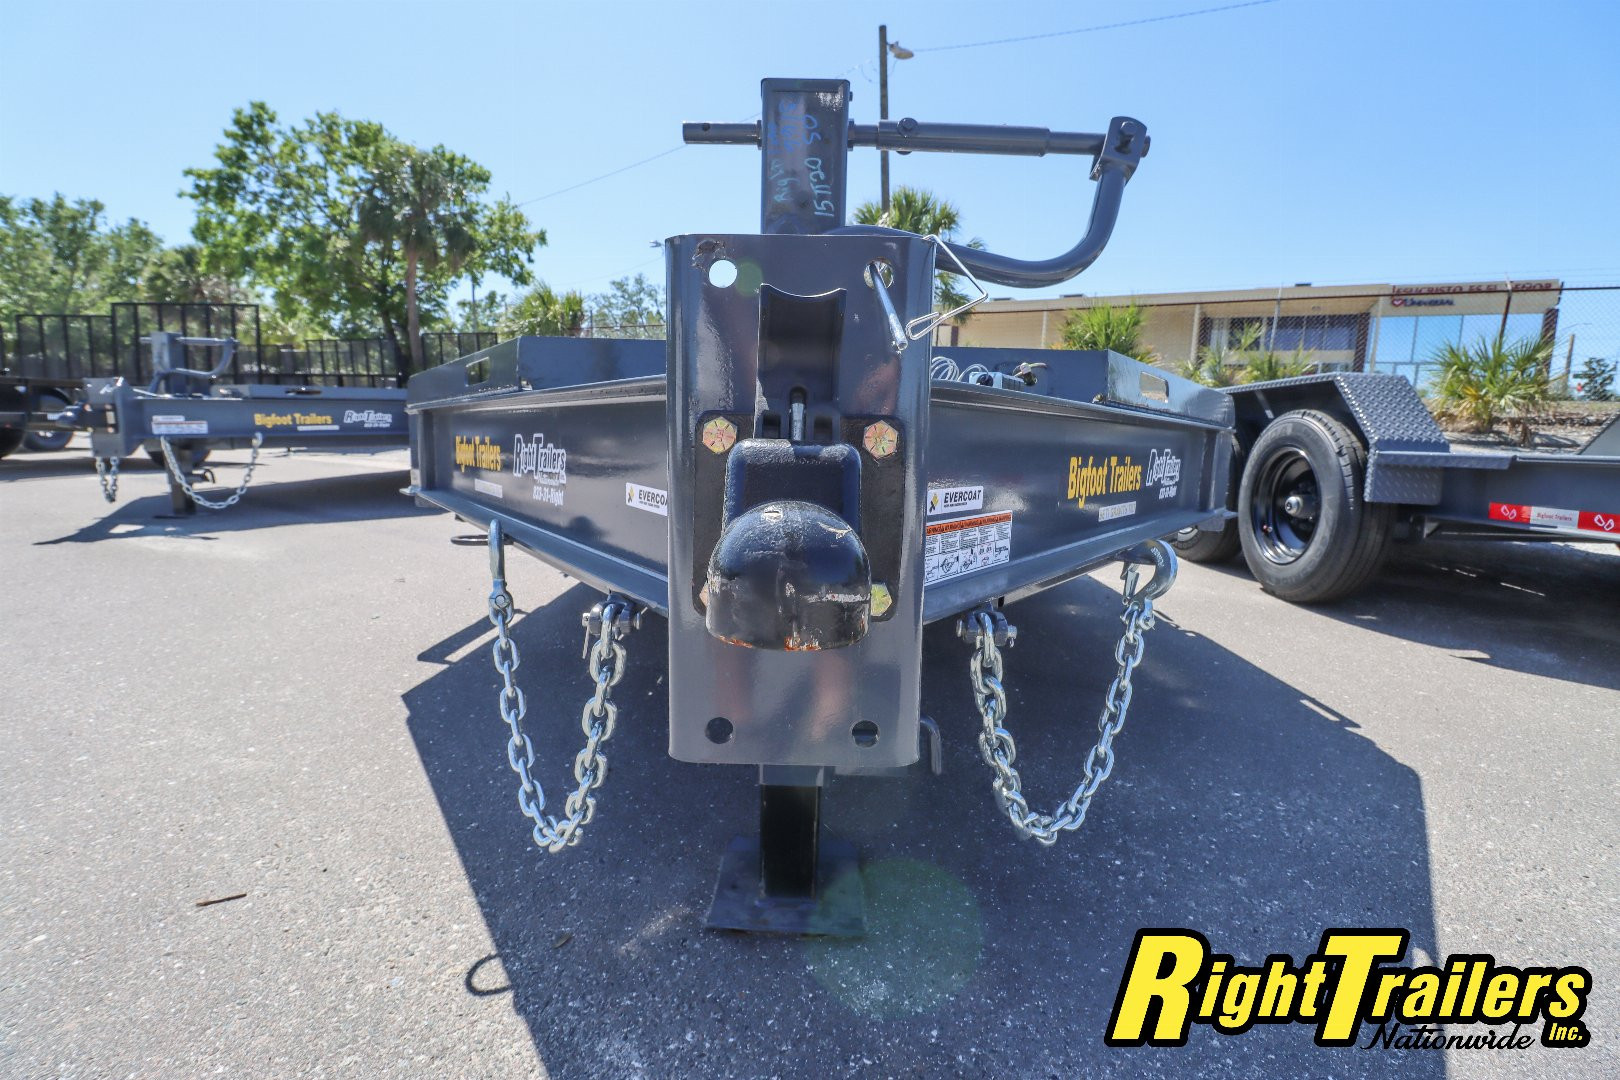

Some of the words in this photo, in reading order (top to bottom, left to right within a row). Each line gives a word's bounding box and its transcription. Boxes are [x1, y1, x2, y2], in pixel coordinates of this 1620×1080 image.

[254, 413, 292, 428] Bigfoot
[295, 413, 332, 425] Trailers
[475, 436, 501, 471] Trailers
[1067, 456, 1108, 508] Bigfoot
[1110, 456, 1142, 493] Trailers
[943, 490, 982, 504] EVERCOAT
